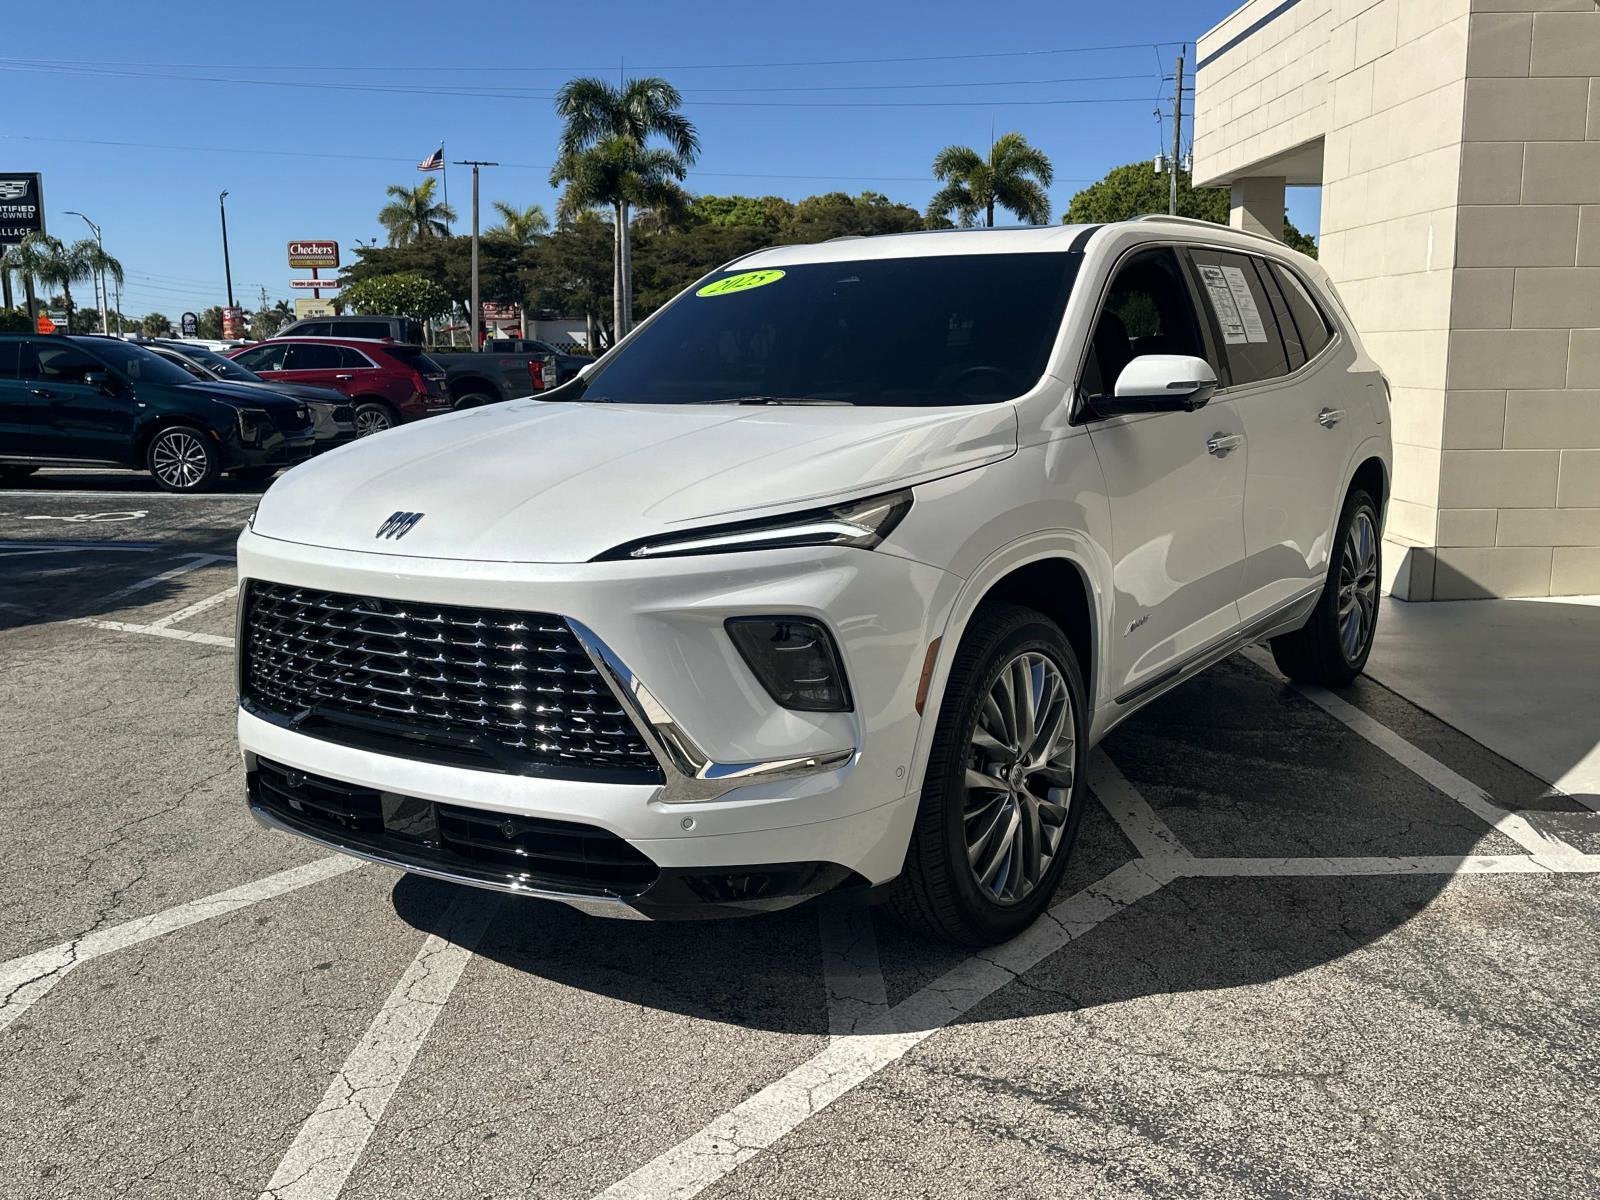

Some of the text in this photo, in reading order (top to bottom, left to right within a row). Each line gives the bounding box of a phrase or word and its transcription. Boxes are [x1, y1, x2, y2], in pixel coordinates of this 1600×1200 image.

[0, 228, 32, 236] LLACE
[290, 243, 332, 255] Checkers
[706, 272, 774, 294] 2025
